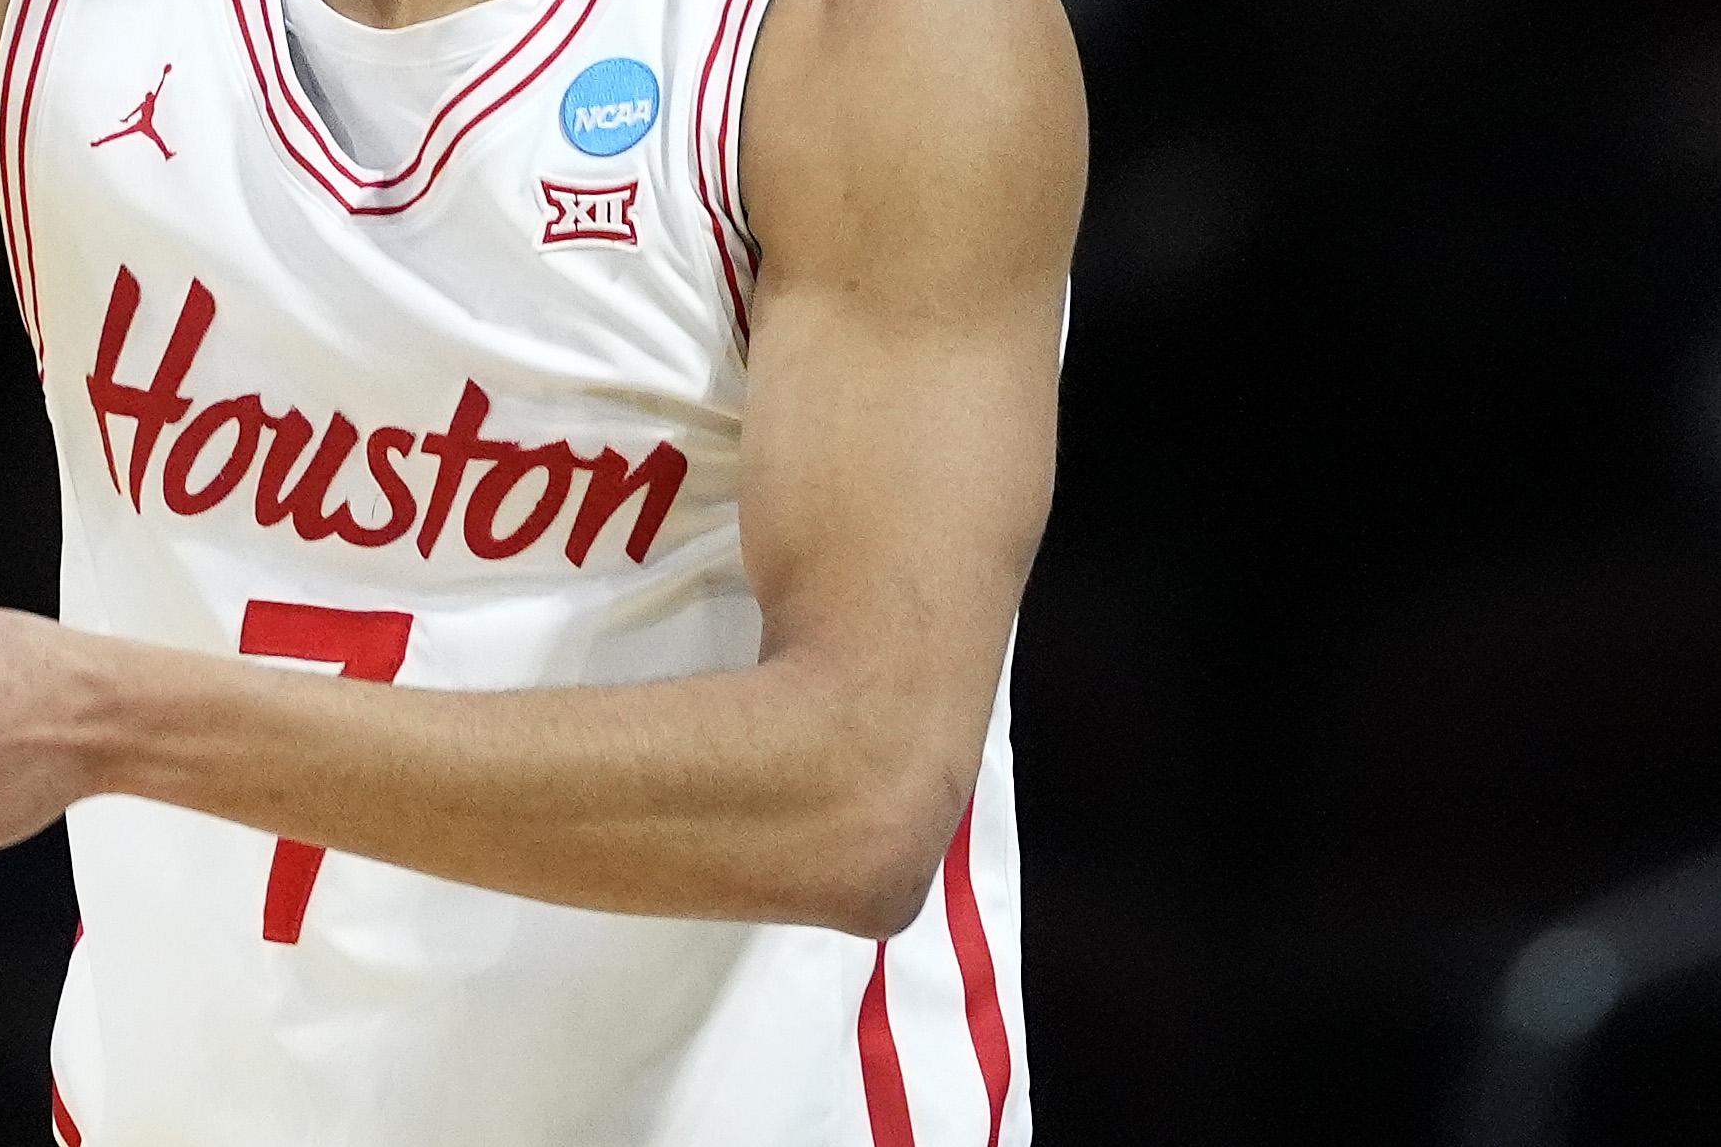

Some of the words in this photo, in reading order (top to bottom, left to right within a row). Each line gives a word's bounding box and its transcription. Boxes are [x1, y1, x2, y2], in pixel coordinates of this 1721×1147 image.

[574, 99, 652, 133] NCAA
[548, 188, 632, 237] XII
[86, 263, 688, 568] Houston
[239, 599, 413, 945] 7
